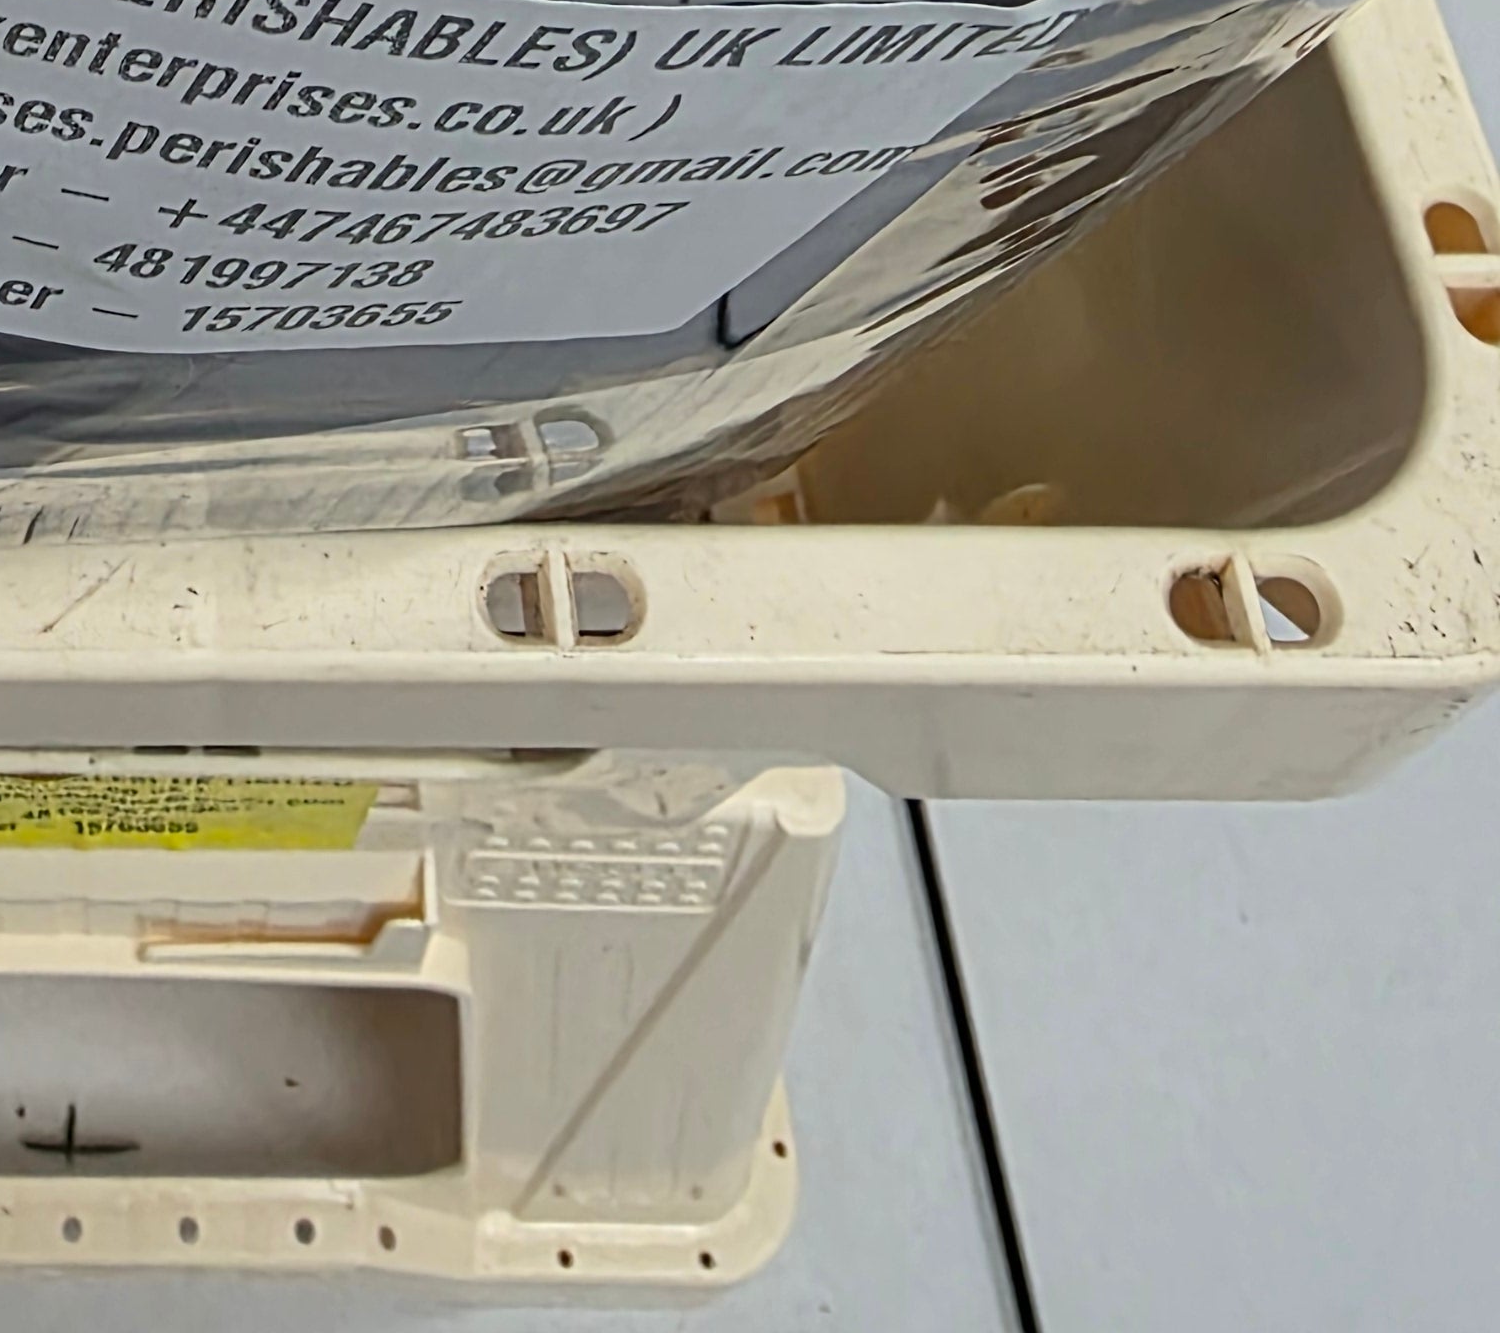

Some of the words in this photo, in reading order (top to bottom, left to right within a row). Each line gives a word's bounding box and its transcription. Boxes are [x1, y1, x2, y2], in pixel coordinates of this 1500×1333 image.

[654, 26, 781, 71] UK
[775, 8, 1092, 66] LIMITED
[94, 244, 434, 289] 481997138
[182, 299, 464, 334] 15703655
